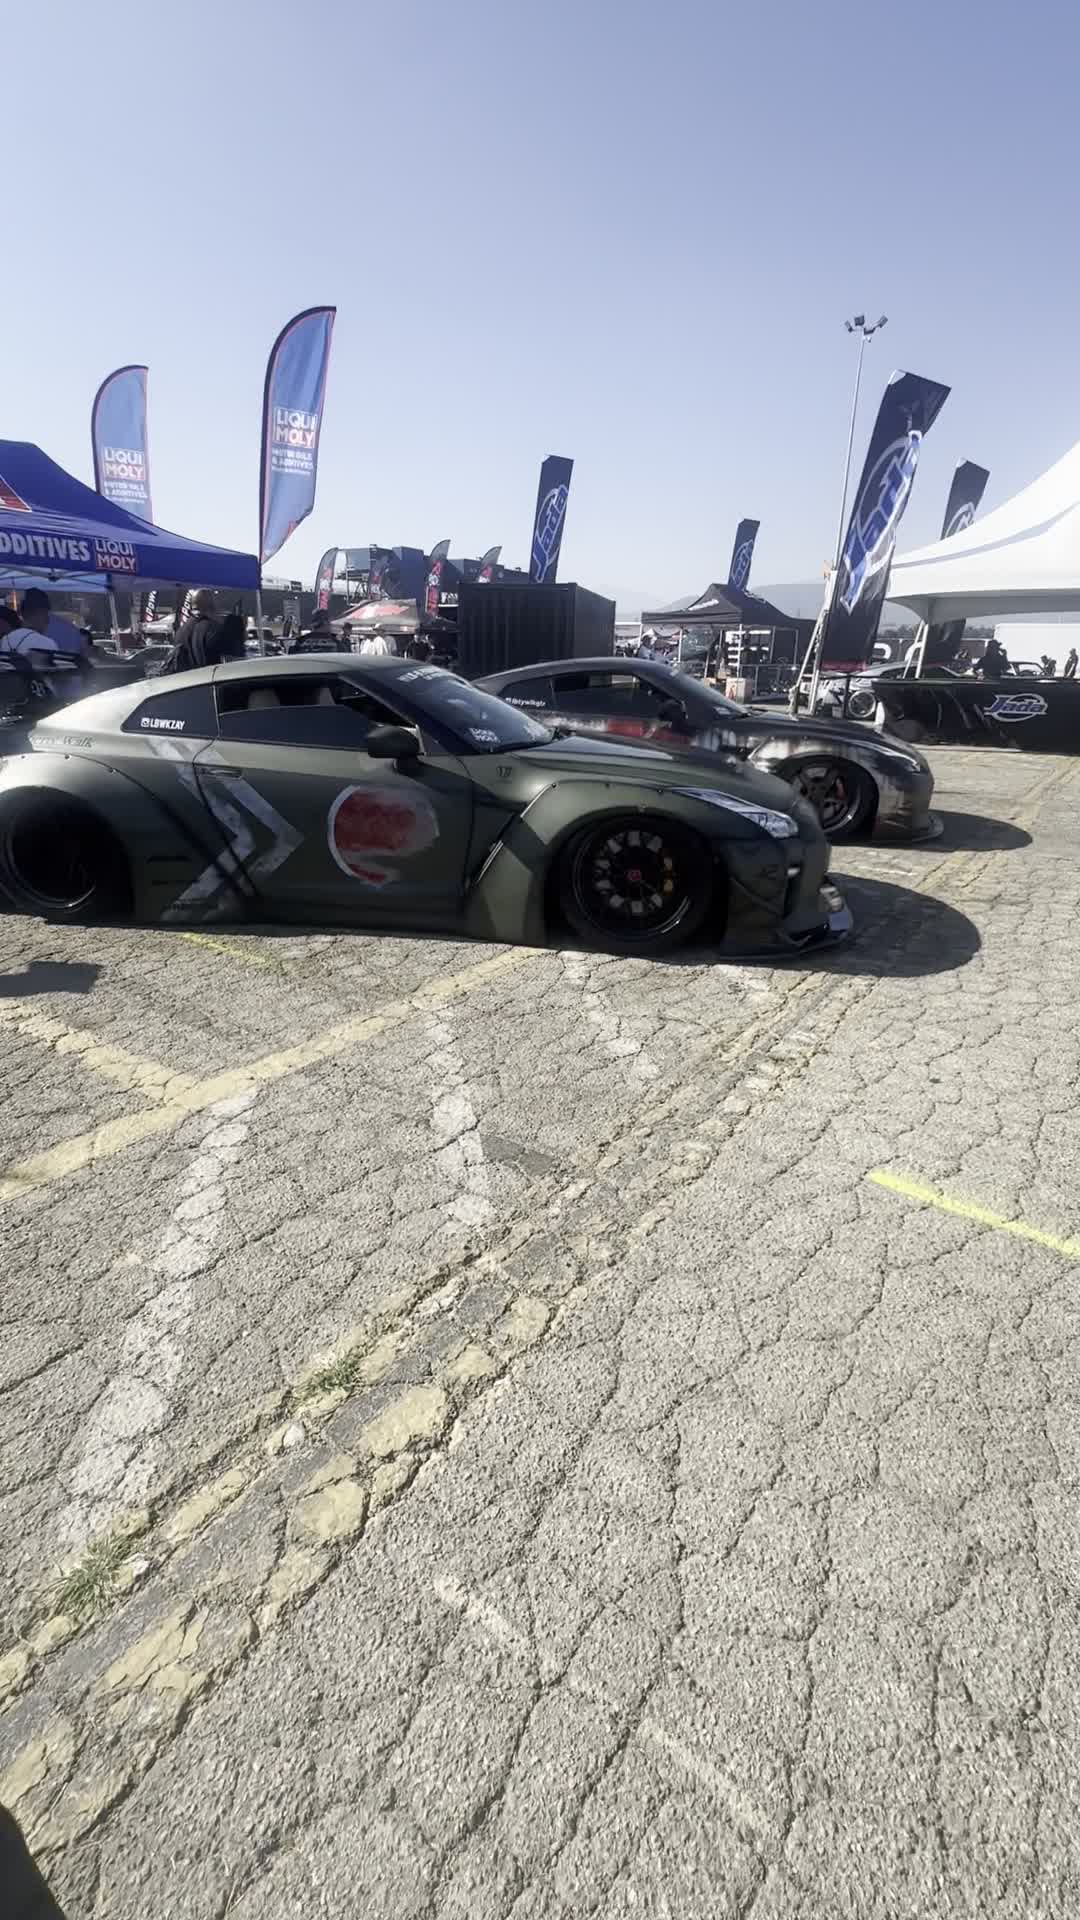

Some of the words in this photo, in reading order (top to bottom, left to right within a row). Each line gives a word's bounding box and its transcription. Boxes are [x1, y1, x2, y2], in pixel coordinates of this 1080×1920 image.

[277, 410, 316, 430] LIQUI
[276, 425, 314, 448] MOLY
[105, 449, 143, 465] LIQUI
[105, 463, 144, 480] MOLY
[0, 531, 90, 562] DDITIVES
[95, 538, 134, 556] LIQUI
[97, 553, 135, 570] MOLY
[984, 694, 1048, 719] Jada
